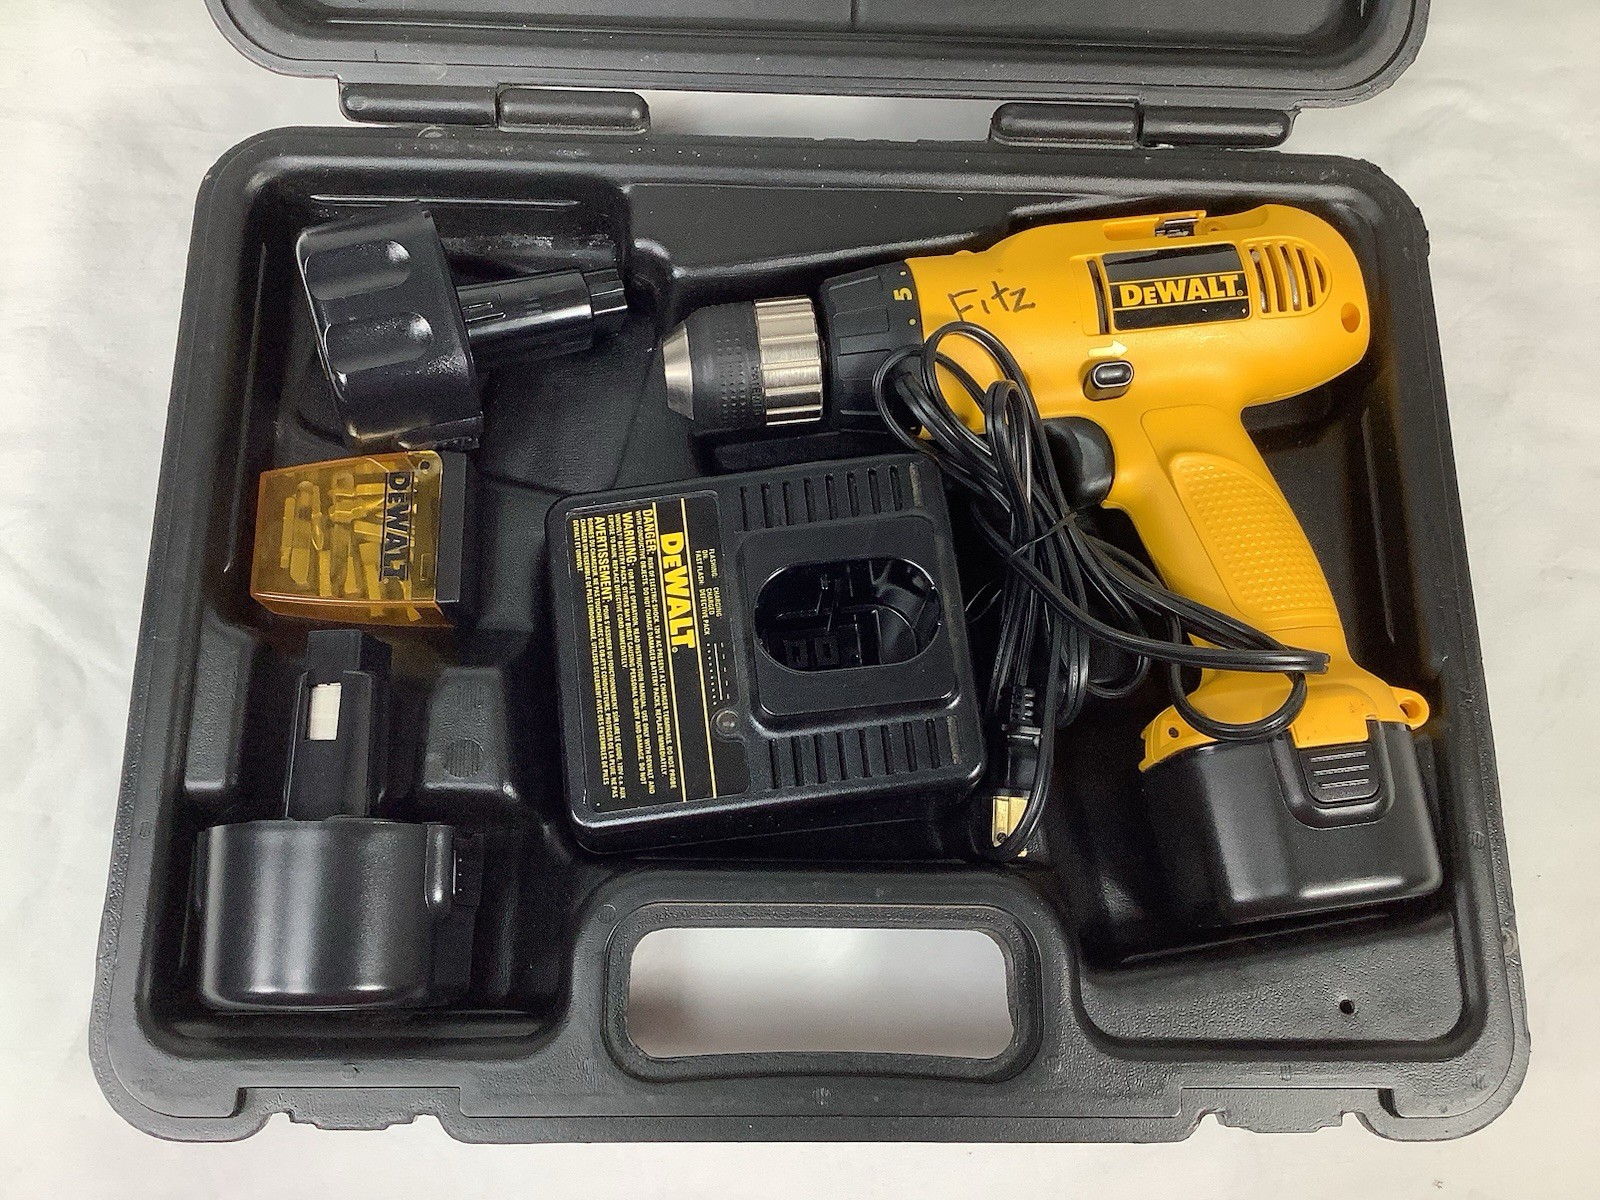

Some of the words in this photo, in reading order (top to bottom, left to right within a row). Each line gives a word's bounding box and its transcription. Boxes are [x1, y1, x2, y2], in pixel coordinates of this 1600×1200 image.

[893, 287, 913, 301] 5
[609, 535, 615, 543] TO
[621, 511, 637, 566] WARNING:
[642, 508, 657, 554] DANGER:
[594, 515, 612, 602] AVERTISSEMENT:
[642, 587, 649, 595] DO
[644, 608, 652, 631] CHARGE
[617, 540, 625, 565] BATTERY
[638, 762, 645, 771] DO
[647, 631, 655, 660] DAMAGED
[650, 660, 658, 686] BATTERY
[656, 648, 664, 673] PRESENT
[659, 674, 665, 682] AT
[660, 682, 668, 710] CHARGER
[666, 745, 673, 754] DO
